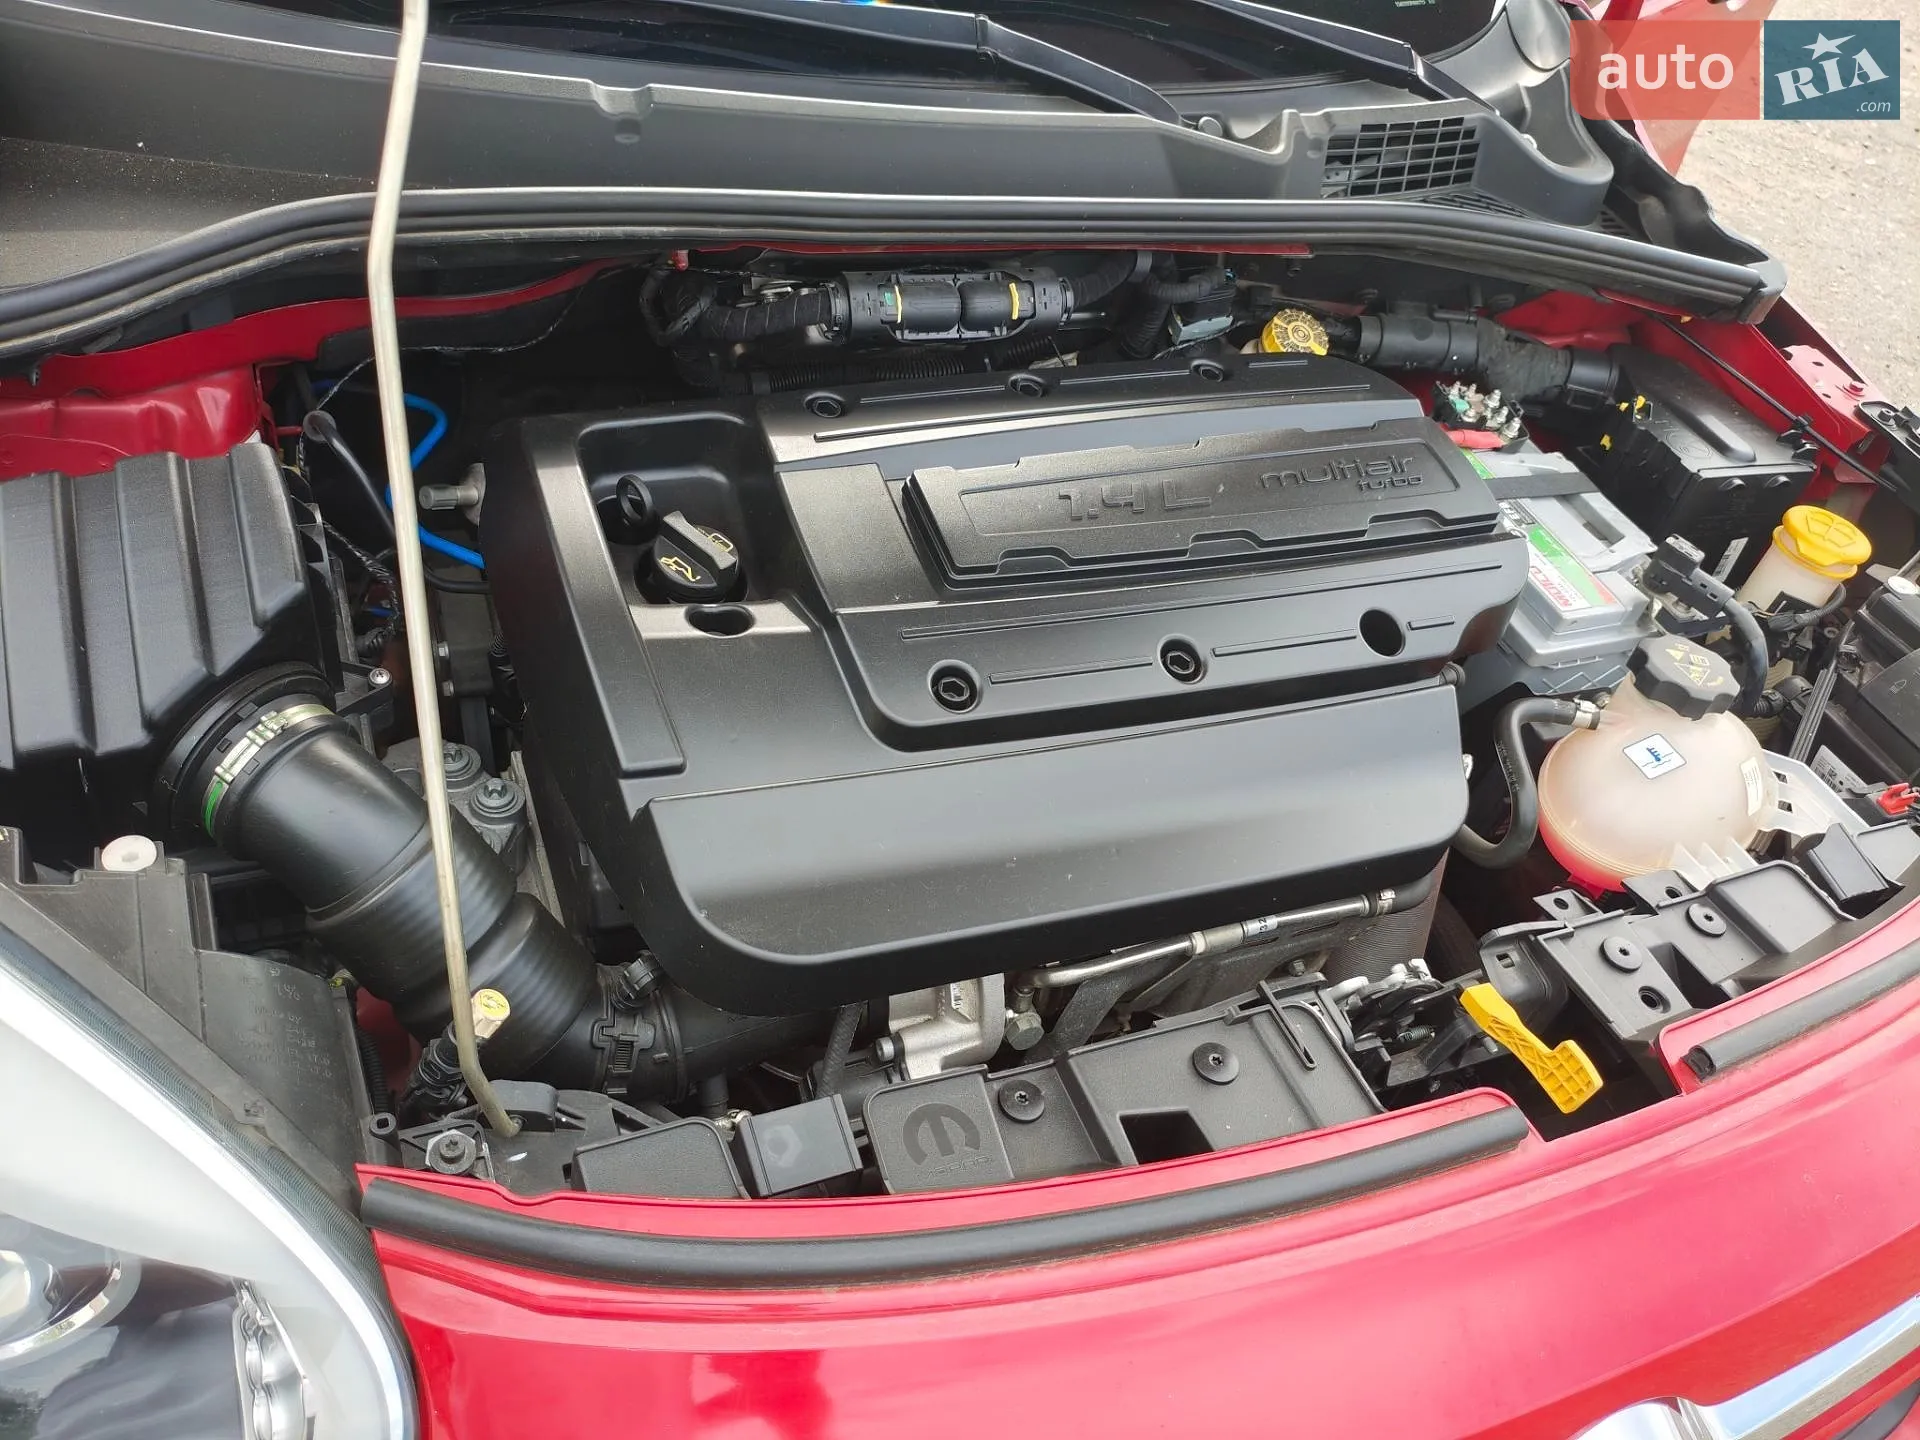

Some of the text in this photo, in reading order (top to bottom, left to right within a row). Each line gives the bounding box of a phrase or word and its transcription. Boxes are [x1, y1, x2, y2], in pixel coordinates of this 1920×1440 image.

[1260, 455, 1414, 489] multiair
[1357, 474, 1424, 492] turbo
[1058, 479, 1211, 521] 1.4 L
